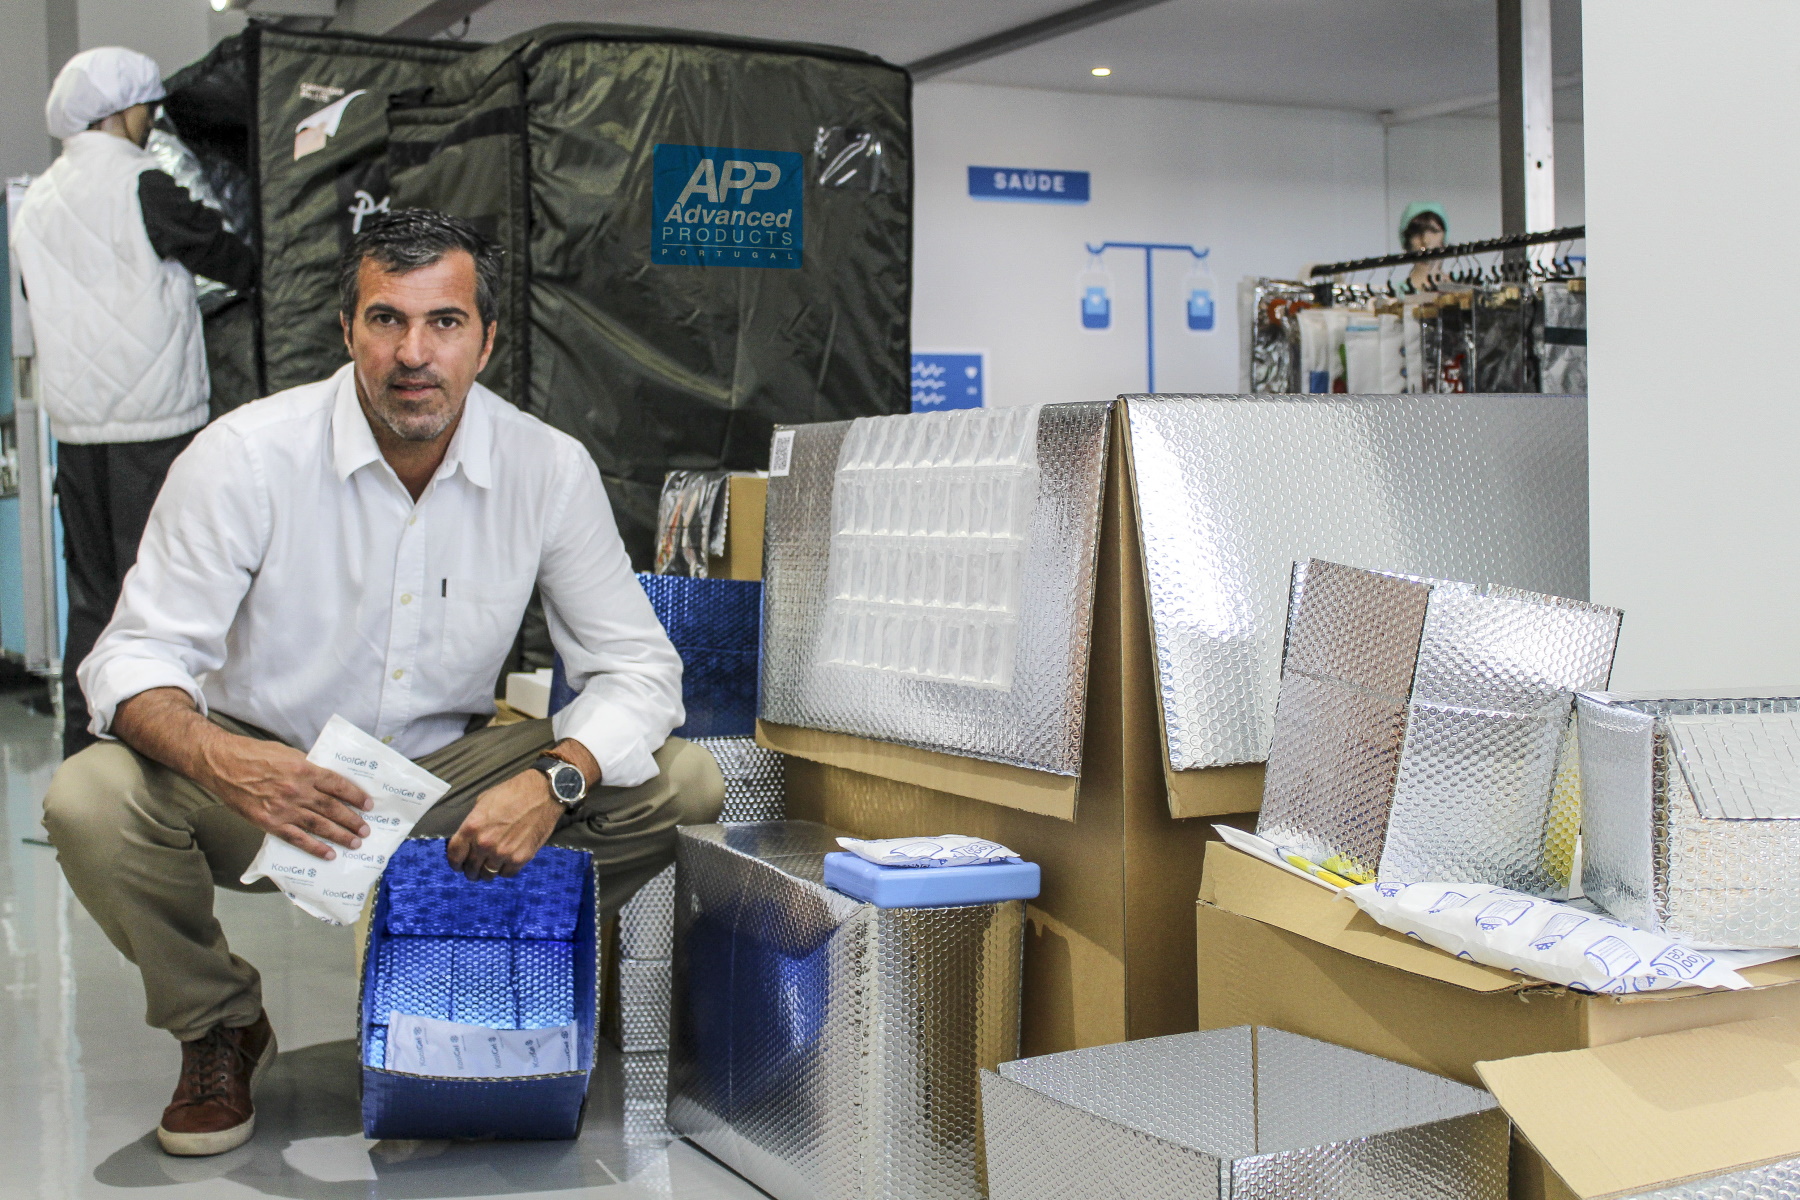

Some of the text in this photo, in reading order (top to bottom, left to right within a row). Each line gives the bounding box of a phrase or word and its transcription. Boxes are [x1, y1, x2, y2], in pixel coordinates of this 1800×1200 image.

[676, 158, 781, 207] APP
[993, 169, 1065, 193] SAÚDE
[663, 203, 793, 228] Advanced
[662, 226, 793, 246] PRODUCTS
[662, 248, 793, 260] PORTUGAL
[335, 752, 367, 767] KoolGel
[382, 783, 415, 798] KoolGel
[342, 849, 374, 861] KoolGel
[271, 863, 305, 875] KoolGel
[322, 888, 355, 900] KoolGel
